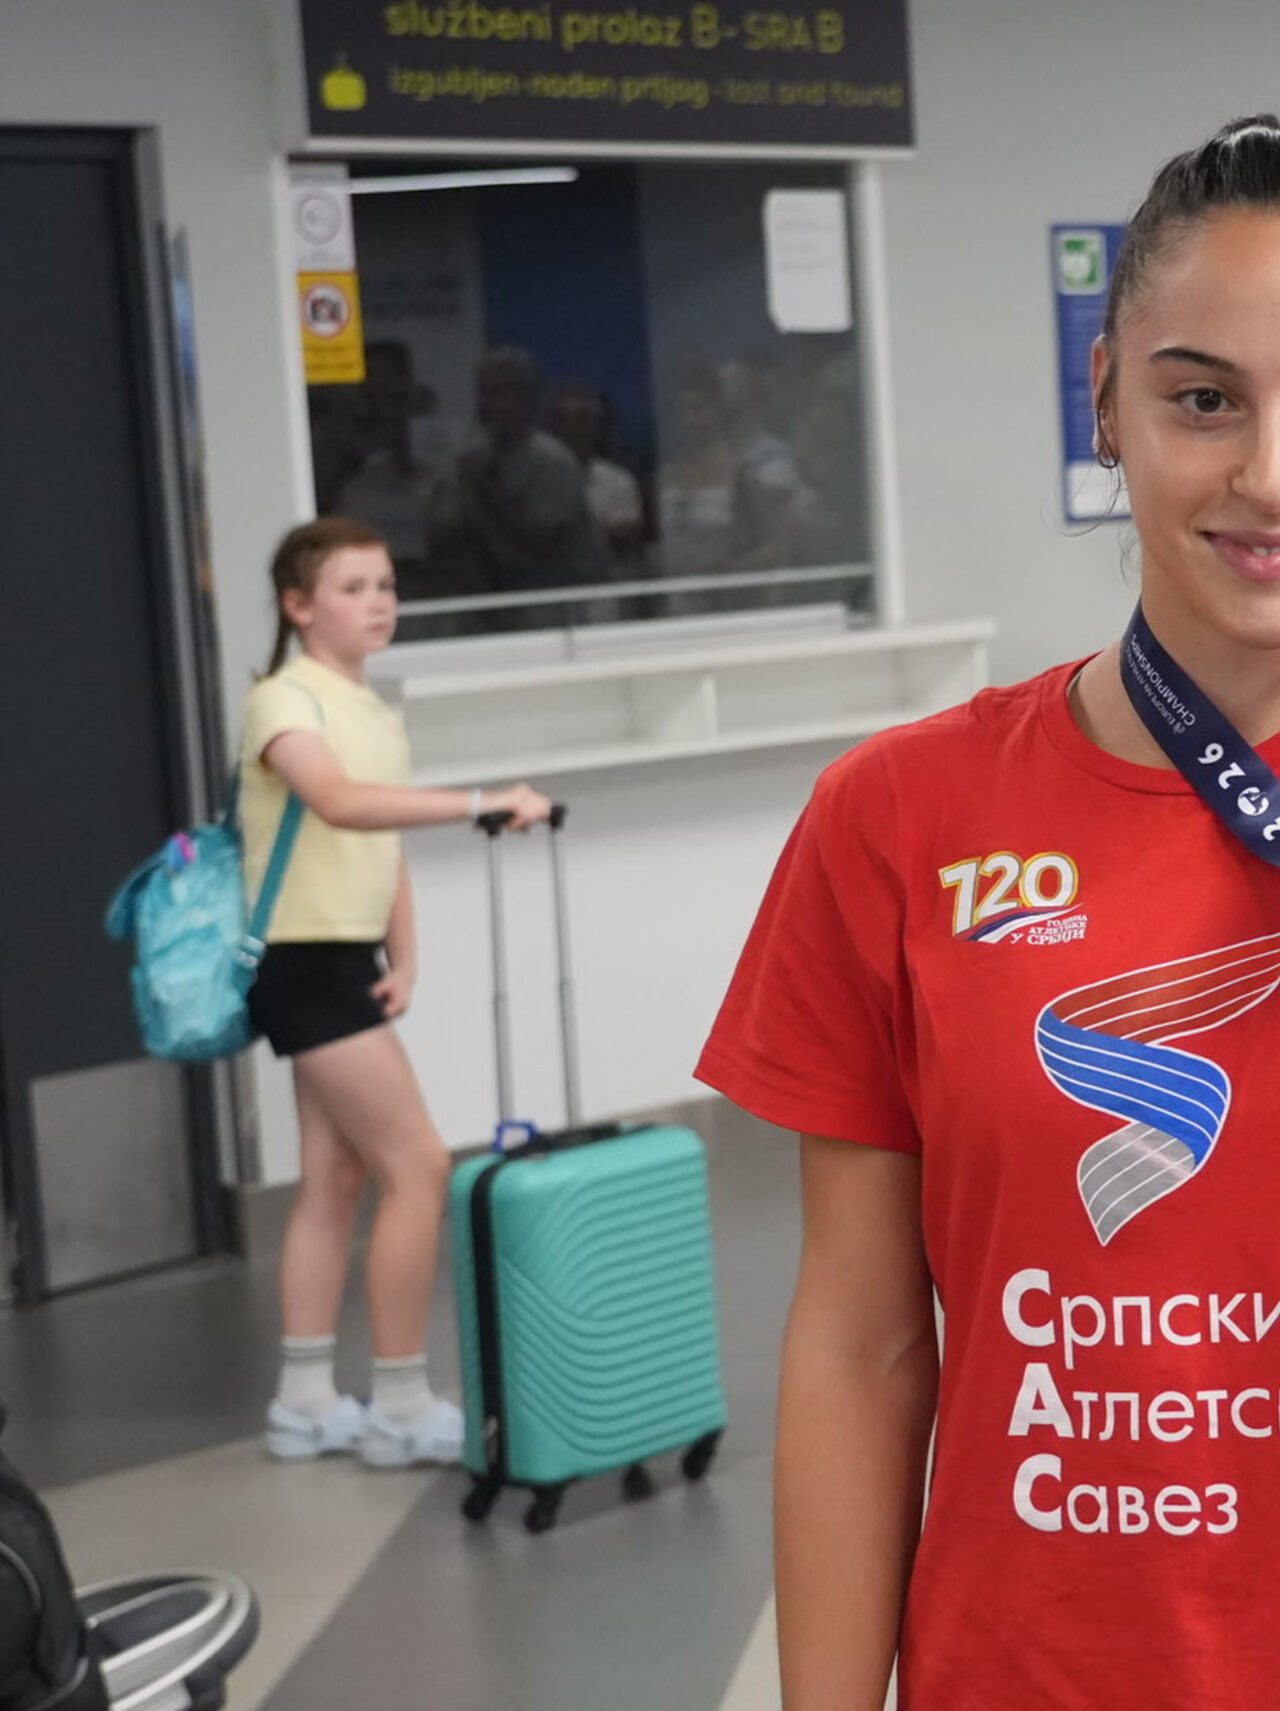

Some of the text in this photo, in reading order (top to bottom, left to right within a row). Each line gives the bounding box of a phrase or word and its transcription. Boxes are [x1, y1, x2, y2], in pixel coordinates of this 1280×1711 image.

[561, 6, 683, 52] prolaz
[816, 9, 845, 53] B
[1130, 633, 1196, 726] CHAMPIONSHIPS
[938, 850, 1079, 937] 120
[1010, 932, 1025, 944] У
[1013, 1453, 1239, 1536] Савез
